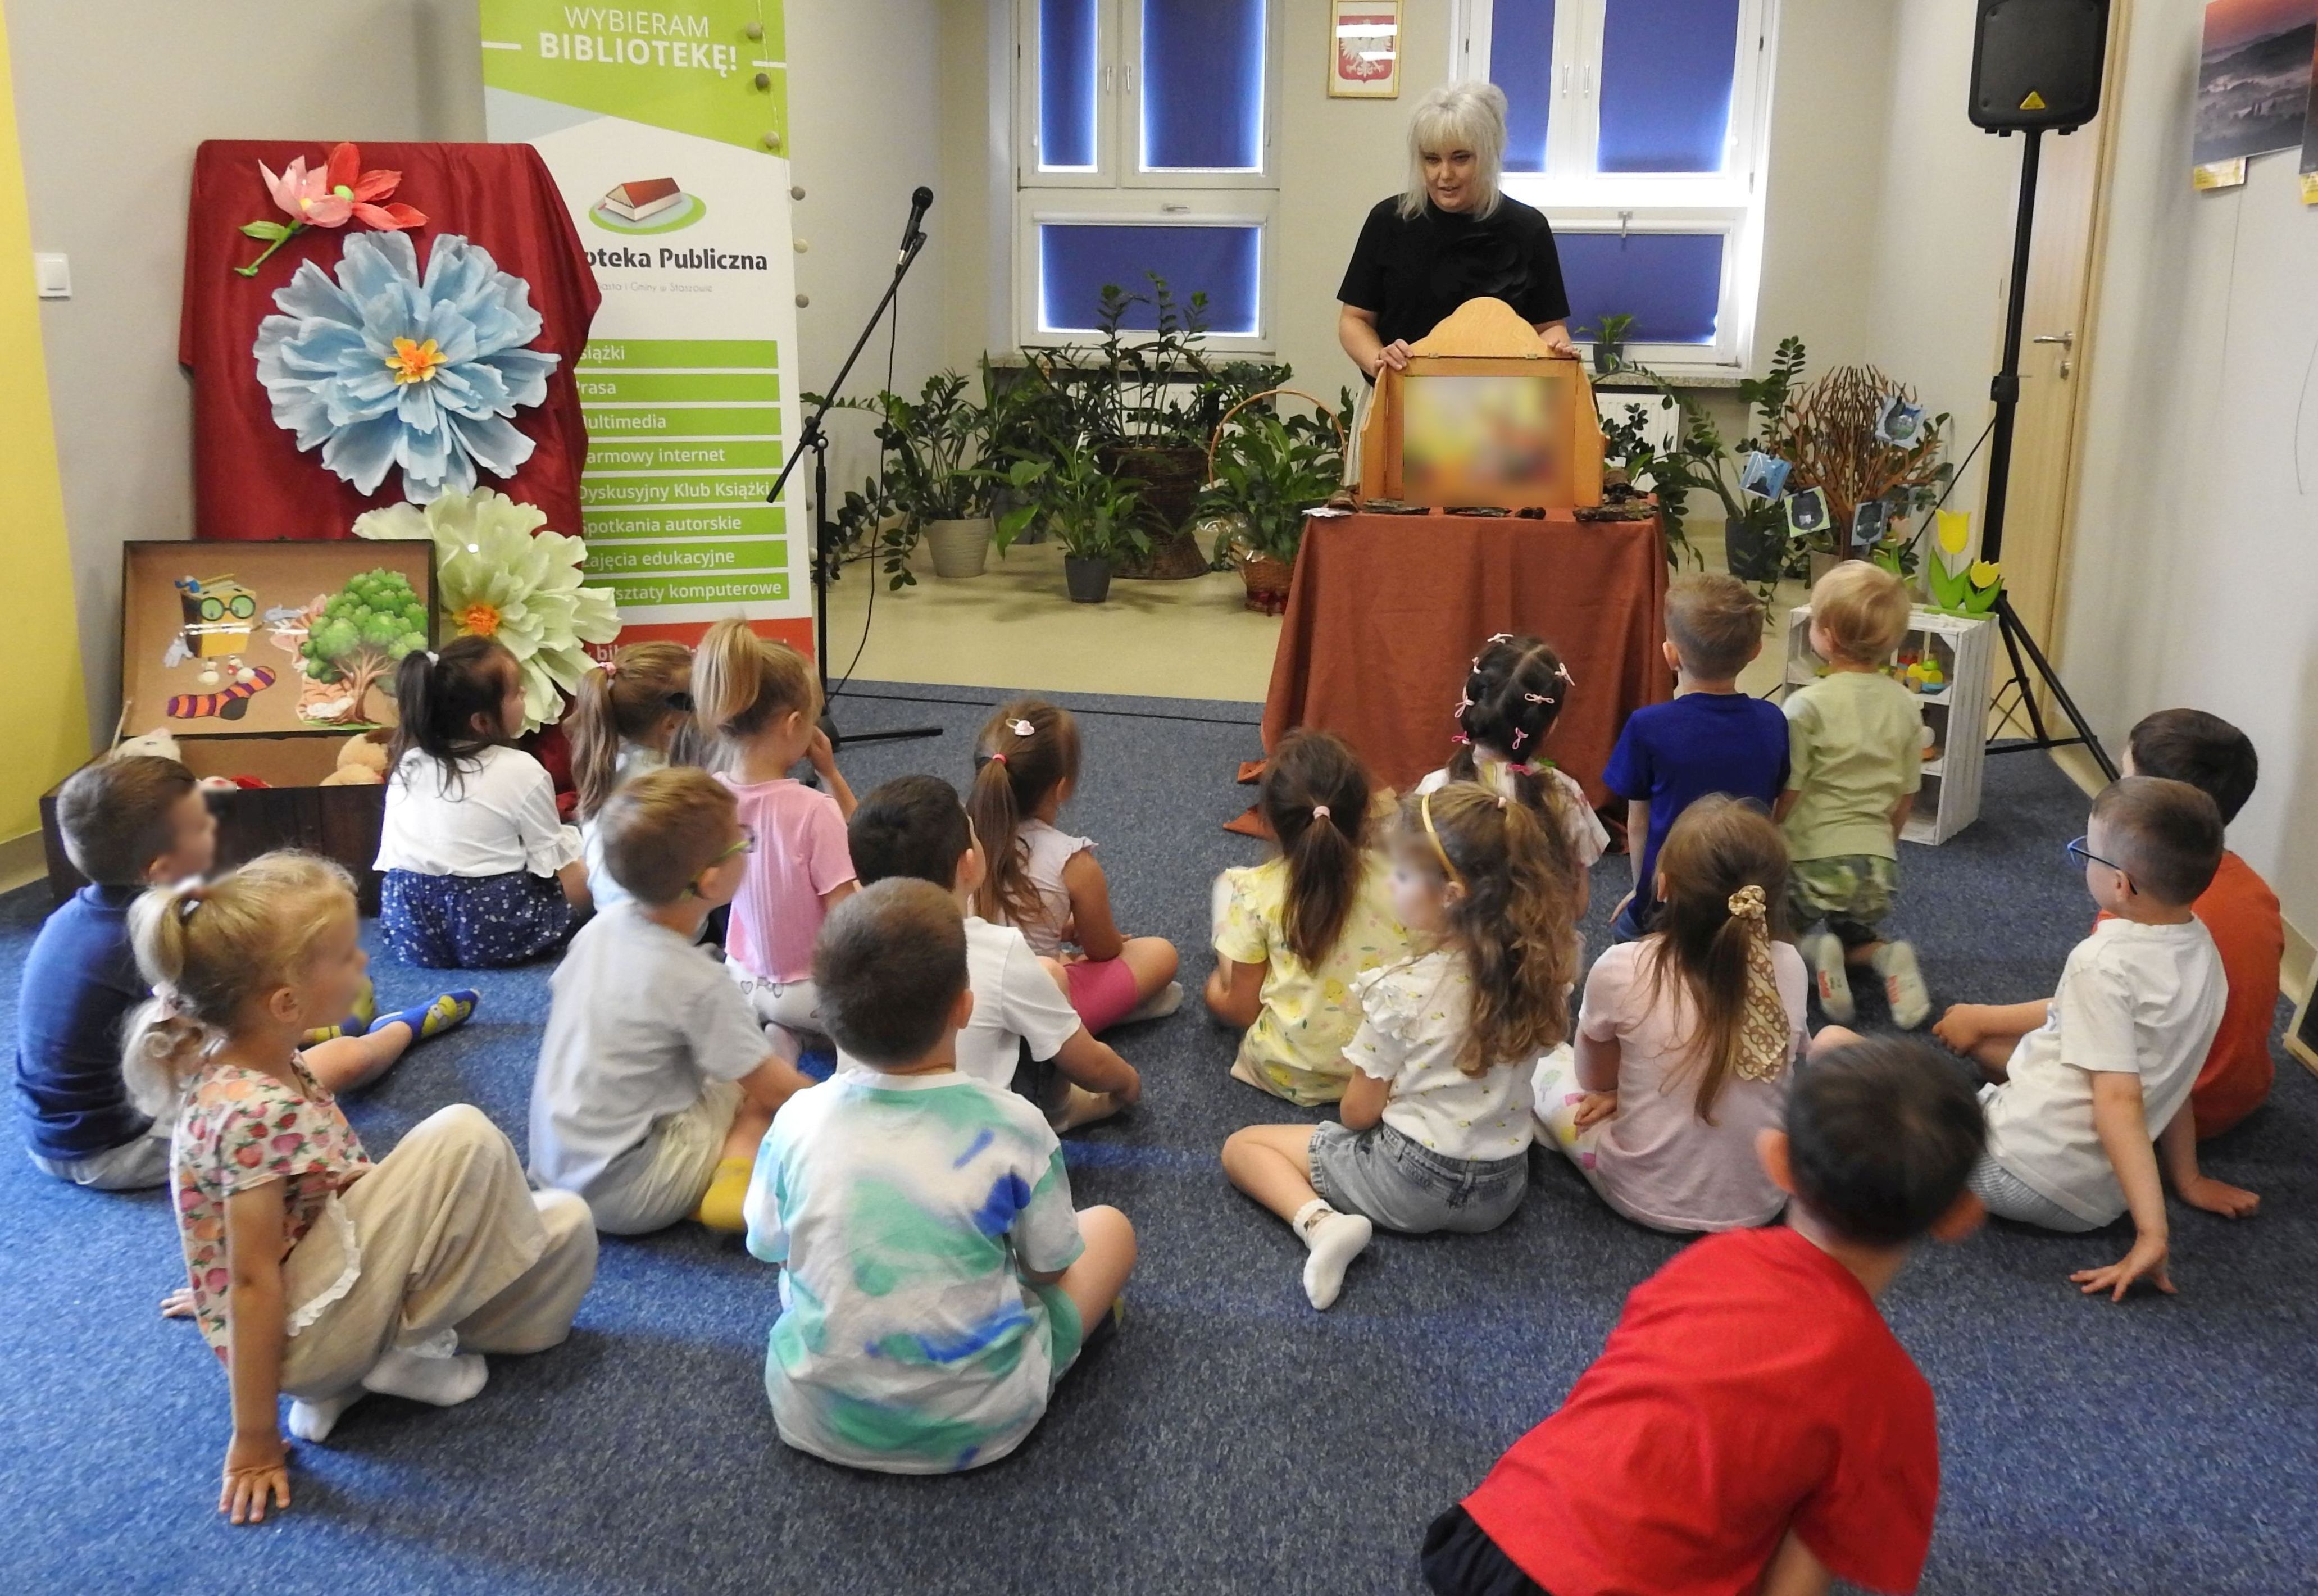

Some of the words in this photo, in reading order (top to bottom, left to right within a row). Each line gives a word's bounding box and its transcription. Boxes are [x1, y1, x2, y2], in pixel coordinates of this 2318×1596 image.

[563, 6, 710, 38] WYBIERAM
[539, 31, 737, 78] BIBLIOTEKĘ!
[659, 248, 767, 270] Publiczna
[576, 380, 616, 394] rasa
[658, 448, 726, 462] internet
[580, 484, 669, 504] Dyskusyjny
[674, 483, 710, 498] Klub
[715, 481, 770, 499] Książki
[665, 515, 742, 531] autorskie
[642, 549, 735, 569] edukacyjne
[669, 581, 783, 600] komputerowe
